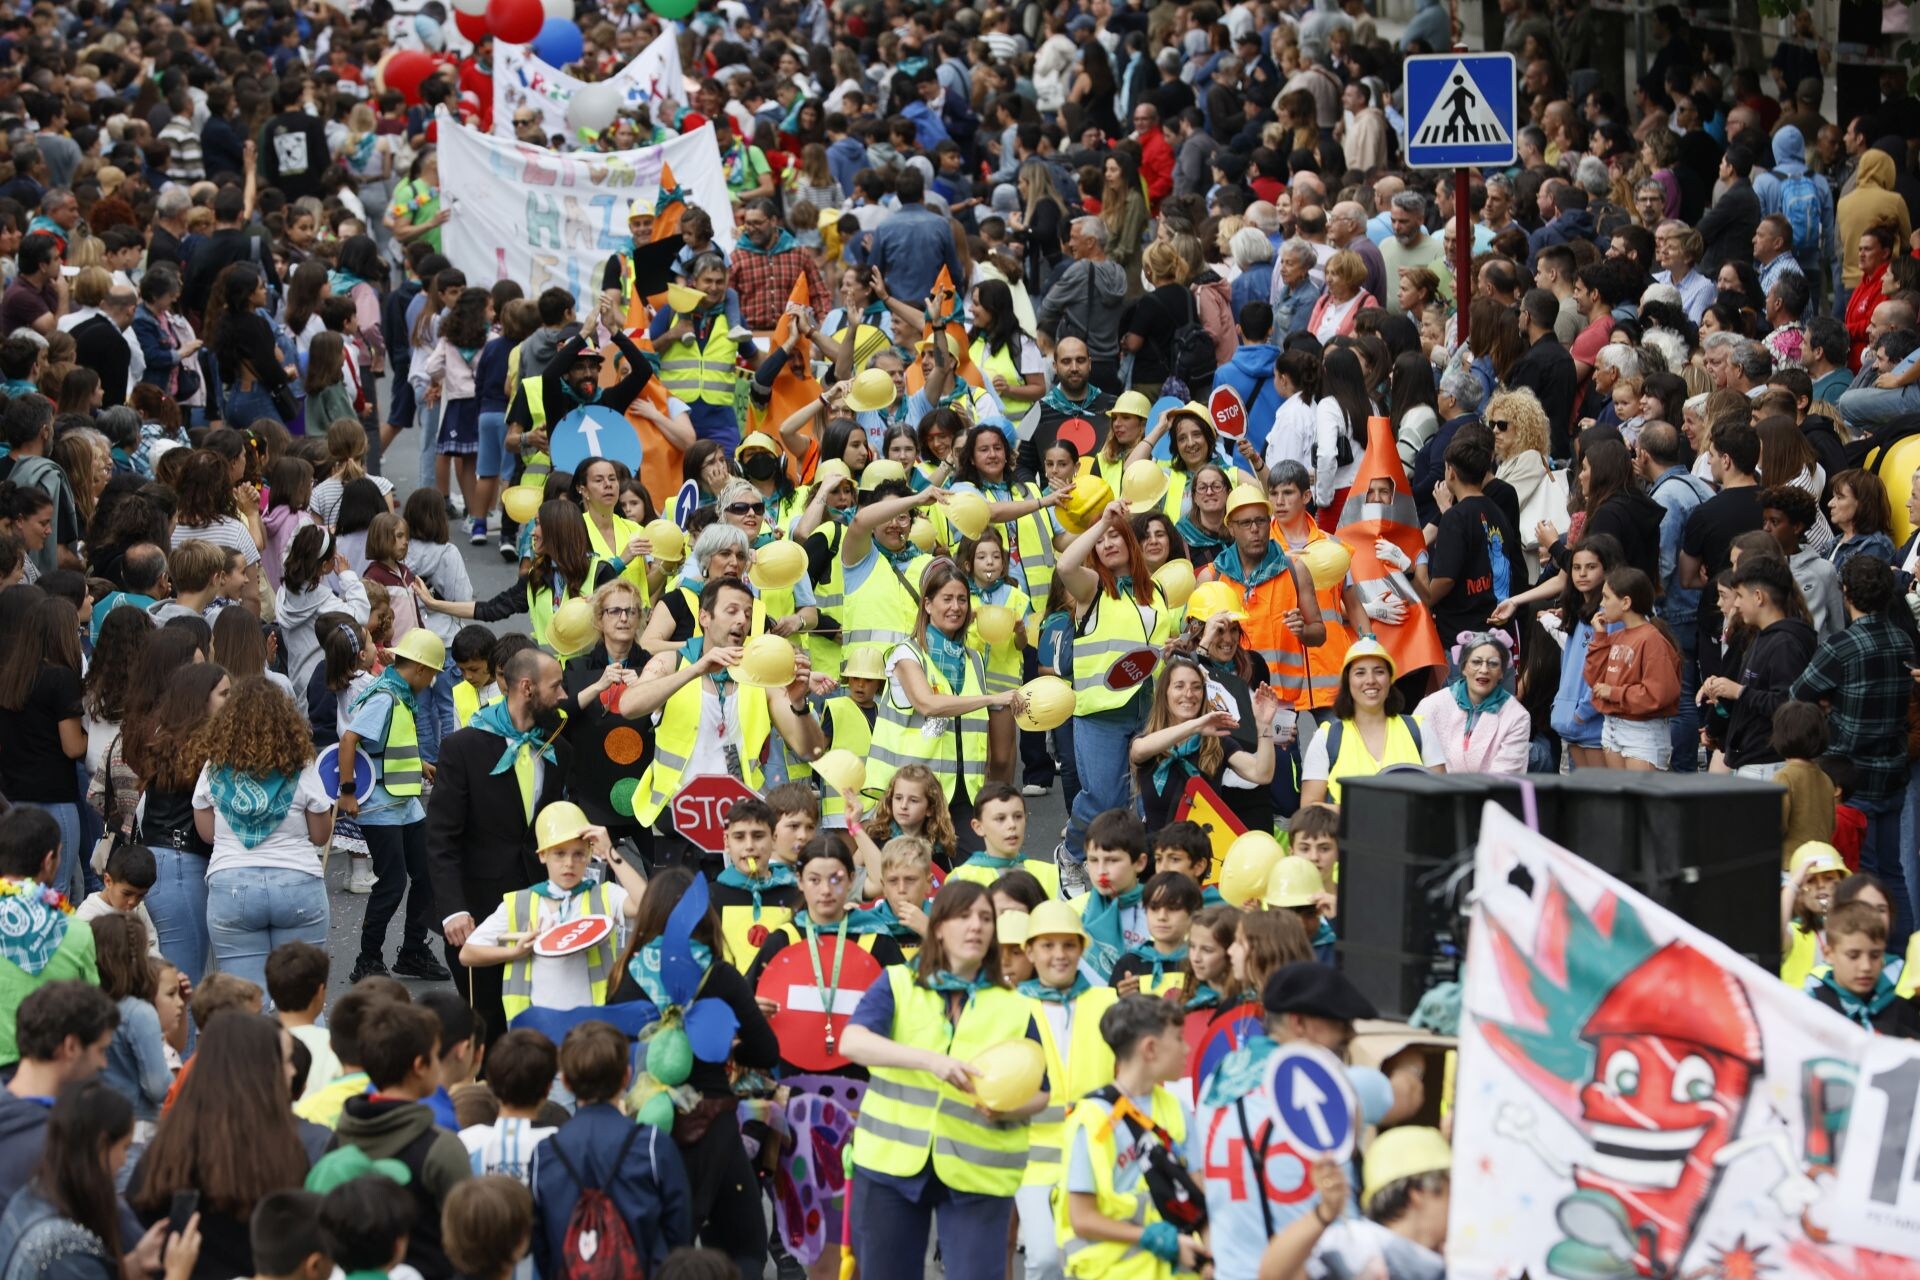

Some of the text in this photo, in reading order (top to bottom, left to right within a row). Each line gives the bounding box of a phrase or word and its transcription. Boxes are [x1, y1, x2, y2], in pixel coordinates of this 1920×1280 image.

[526, 191, 634, 249] HAZ
[1216, 404, 1239, 423] STOP
[1121, 659, 1144, 681] STOP
[675, 794, 749, 831] STO
[555, 920, 595, 950] STOP
[1869, 1056, 1920, 1206] 1
